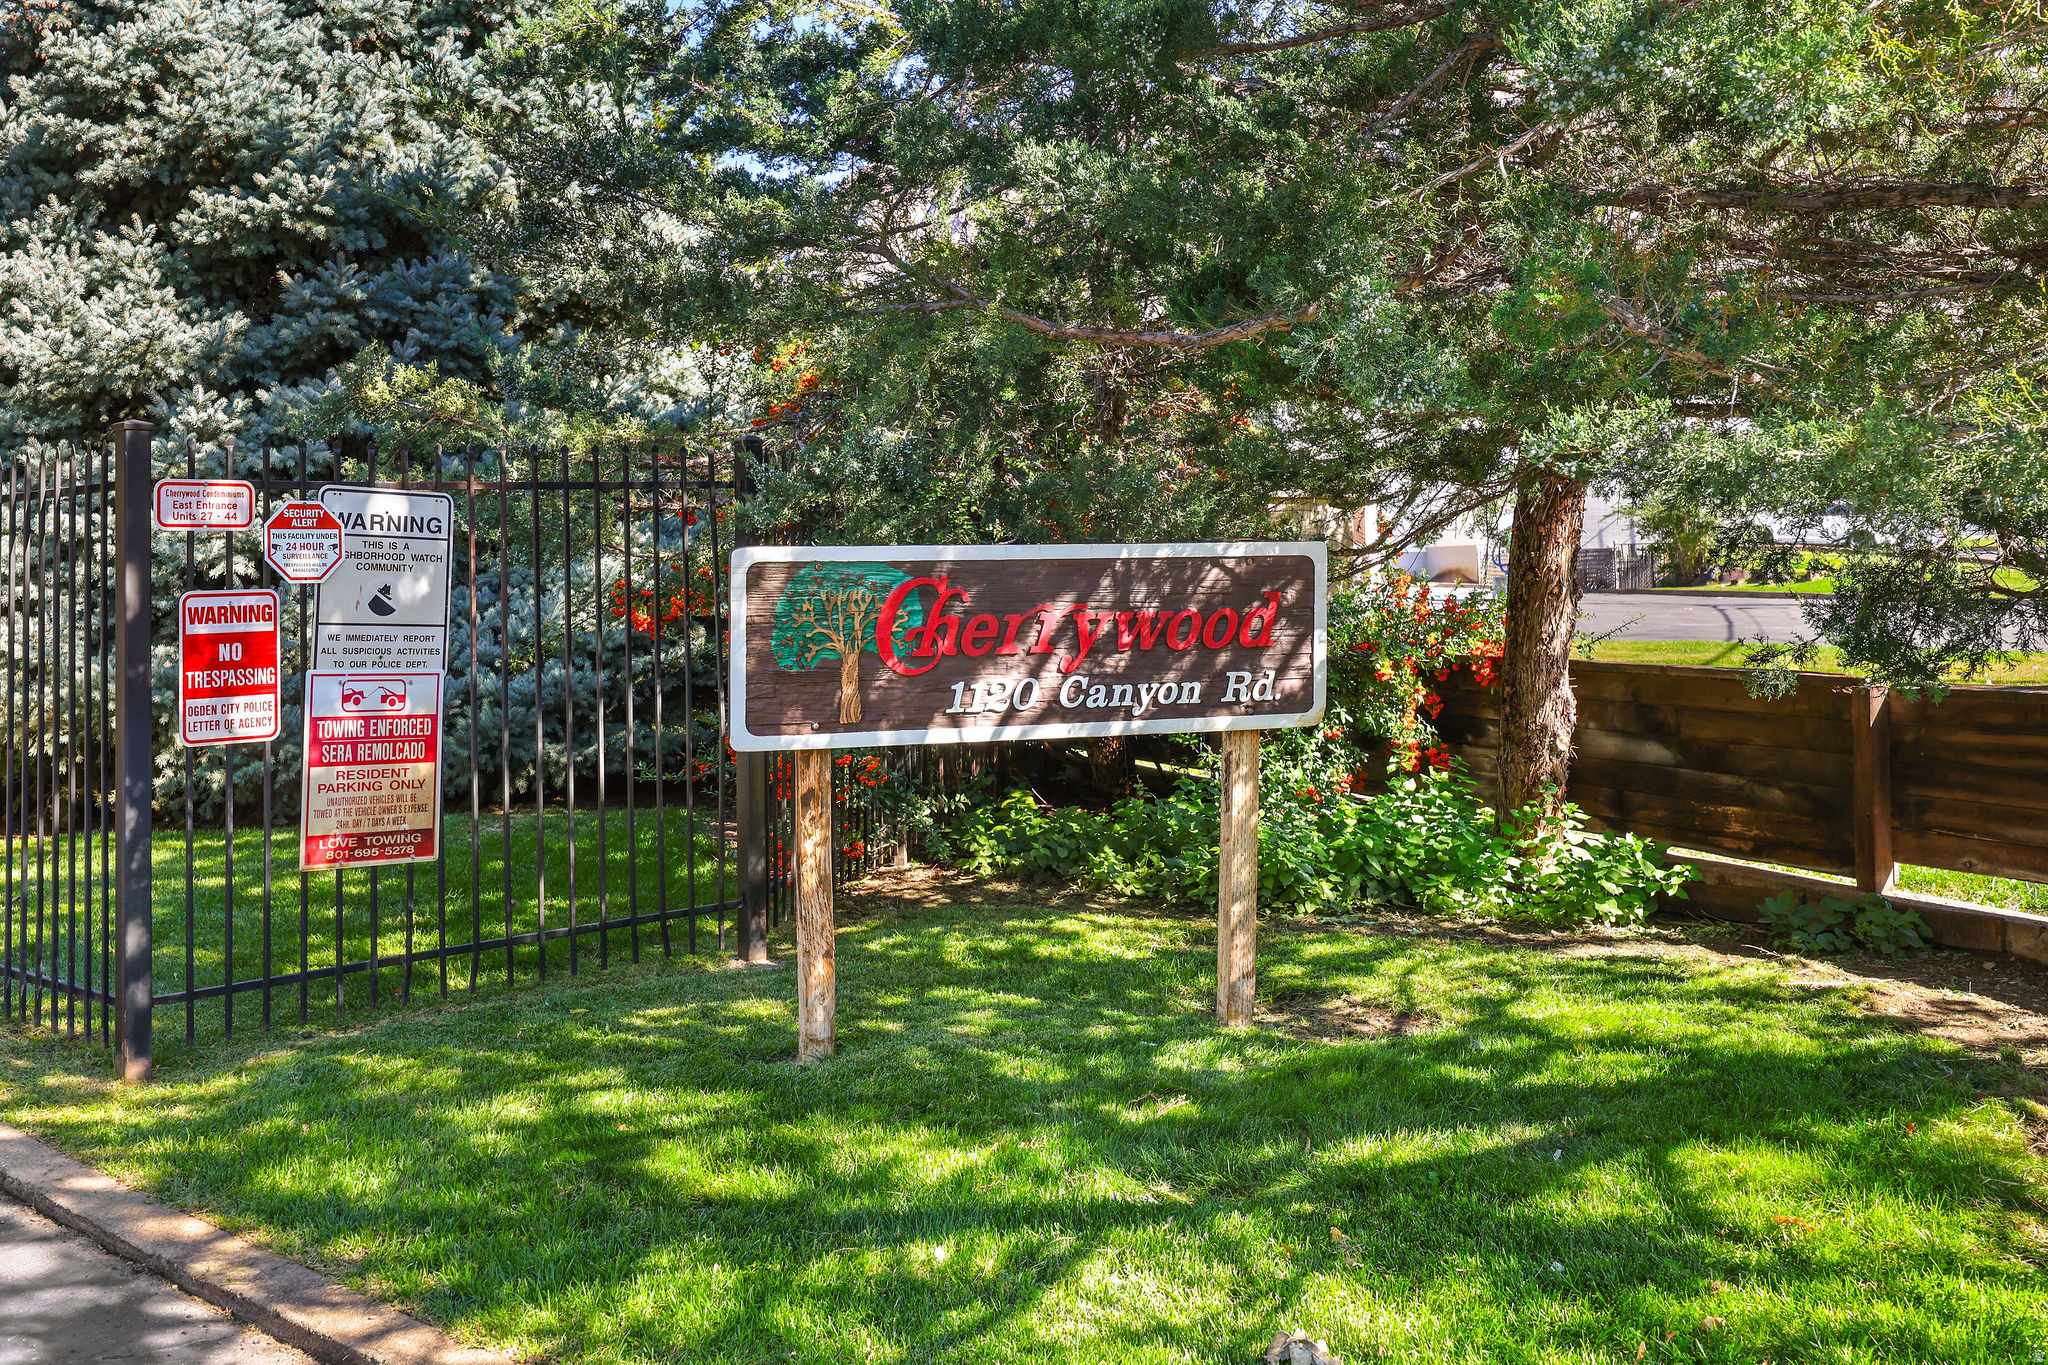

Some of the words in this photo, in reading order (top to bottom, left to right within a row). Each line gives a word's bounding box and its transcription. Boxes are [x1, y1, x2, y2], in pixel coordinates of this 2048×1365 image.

[166, 489, 200, 499] Cherrywood
[203, 490, 244, 498] Condominiums
[173, 501, 192, 509] East
[196, 501, 238, 509] Entrance
[172, 512, 196, 520] Units
[200, 512, 213, 520] 27
[224, 512, 237, 520] 44
[283, 509, 325, 518] SECURITY
[291, 519, 317, 527] ALERT
[362, 541, 384, 549] THIS
[388, 542, 398, 550] IS
[345, 550, 405, 561] GHBORHOOD
[411, 554, 443, 562] WATCH
[356, 562, 414, 572] COMMUNITY
[188, 604, 272, 625] WARNING
[874, 575, 1281, 677] Cherrywood
[328, 634, 340, 642] WE
[346, 634, 398, 642] IMMEDIATELY
[218, 643, 242, 662] NO
[186, 667, 275, 689] TRESPASSING
[946, 676, 1040, 715] 1120
[1058, 673, 1201, 716] Canyon
[1220, 670, 1282, 704] Rd.
[188, 705, 217, 717] OGDEN
[221, 703, 240, 715] CITY
[244, 700, 273, 713] POLICE
[188, 719, 220, 733] LETTER
[224, 719, 235, 730] OF
[238, 716, 272, 729] AGENCY
[317, 719, 365, 738] TOWING
[370, 718, 432, 737] ENFORCED
[322, 744, 352, 763] SERA
[357, 741, 426, 761] REMOLCADO
[336, 768, 410, 780] RESIDENT
[318, 781, 382, 794] PARKING
[390, 778, 426, 790] ONLY
[327, 796, 367, 807] UNAUTHORIZED
[369, 794, 394, 806] VEHICLES
[396, 794, 409, 803] WILL
[410, 793, 417, 802] BE
[314, 808, 332, 819] TOWED
[334, 808, 341, 817] AT
[343, 807, 353, 817] THE
[355, 806, 376, 816] VEHICLE
[378, 804, 402, 815] OWNER'S
[352, 819, 362, 828] DAY
[371, 818, 386, 827] DAYS
[386, 817, 390, 826] A
[319, 837, 357, 849] LOVE
[364, 833, 422, 846] TOWING
[326, 846, 415, 860] 801-695-5278
